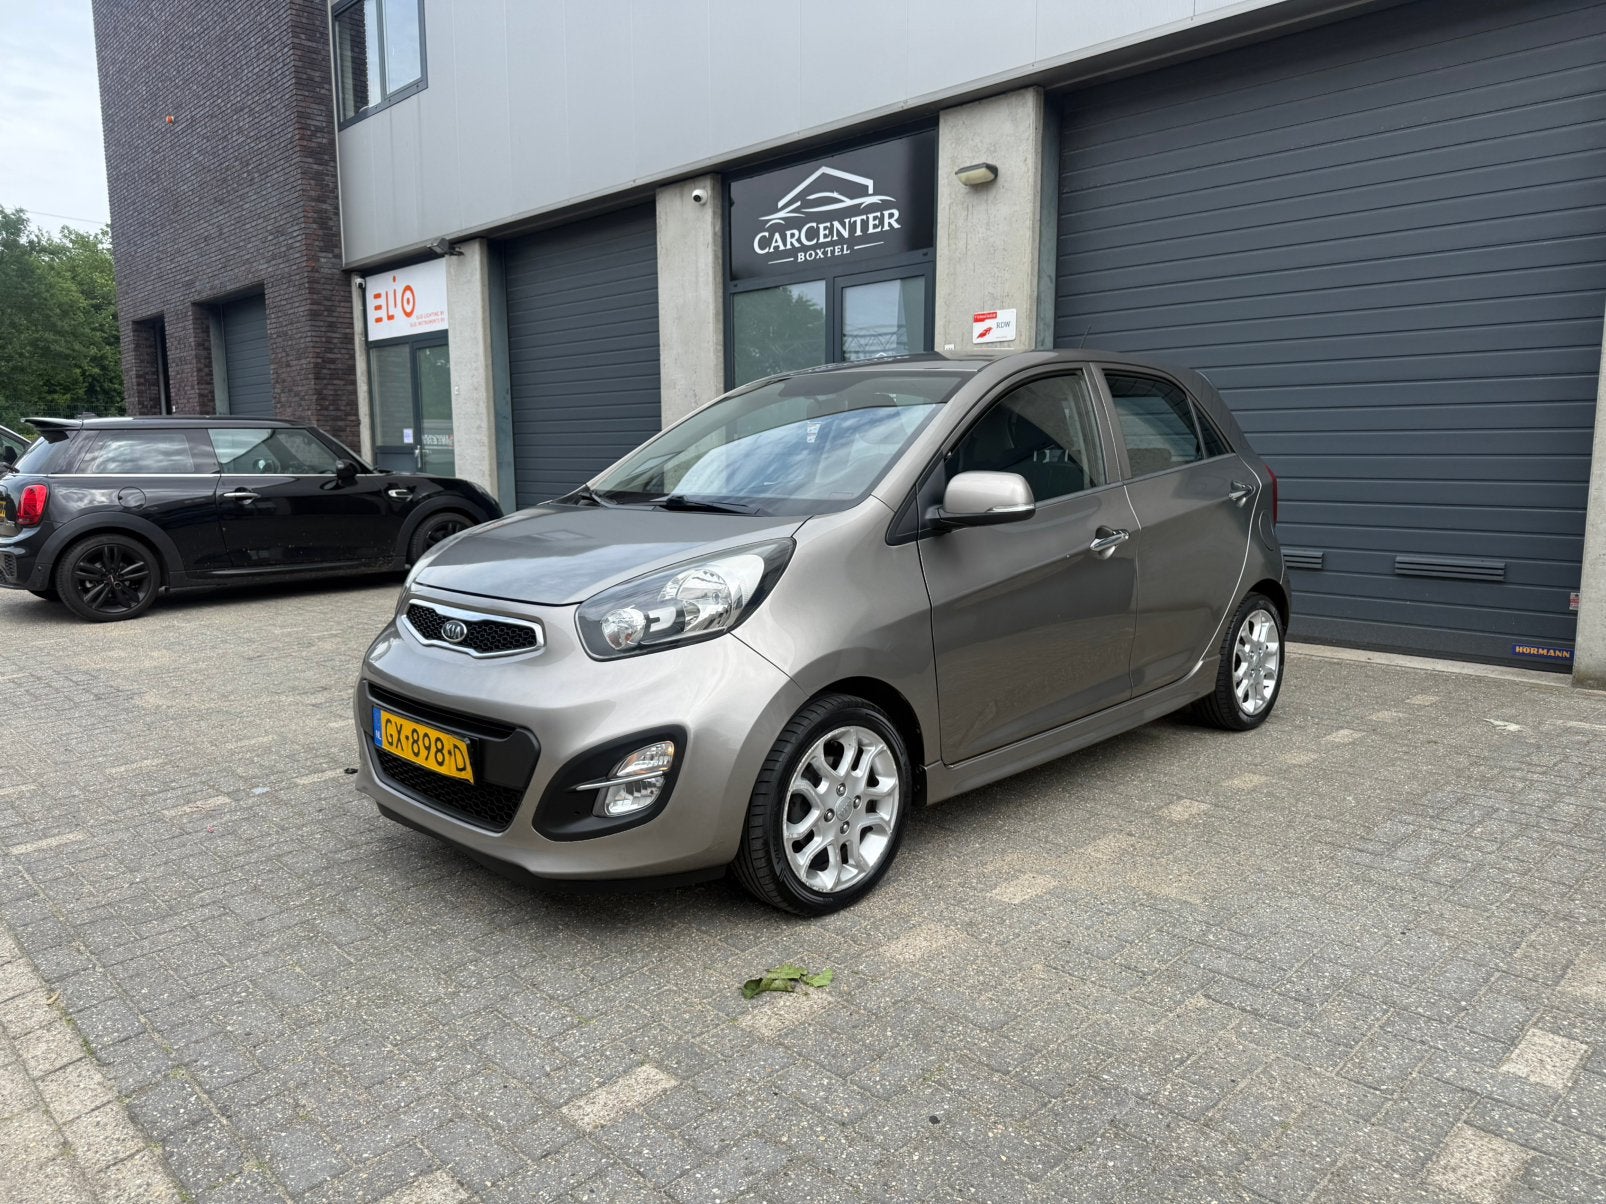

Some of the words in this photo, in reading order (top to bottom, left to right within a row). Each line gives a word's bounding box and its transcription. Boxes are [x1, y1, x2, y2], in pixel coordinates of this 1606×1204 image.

[797, 245, 850, 262] BOXTEL
[996, 321, 1011, 329] RDW
[446, 623, 461, 639] KIA
[385, 718, 467, 772] GX-898-D
